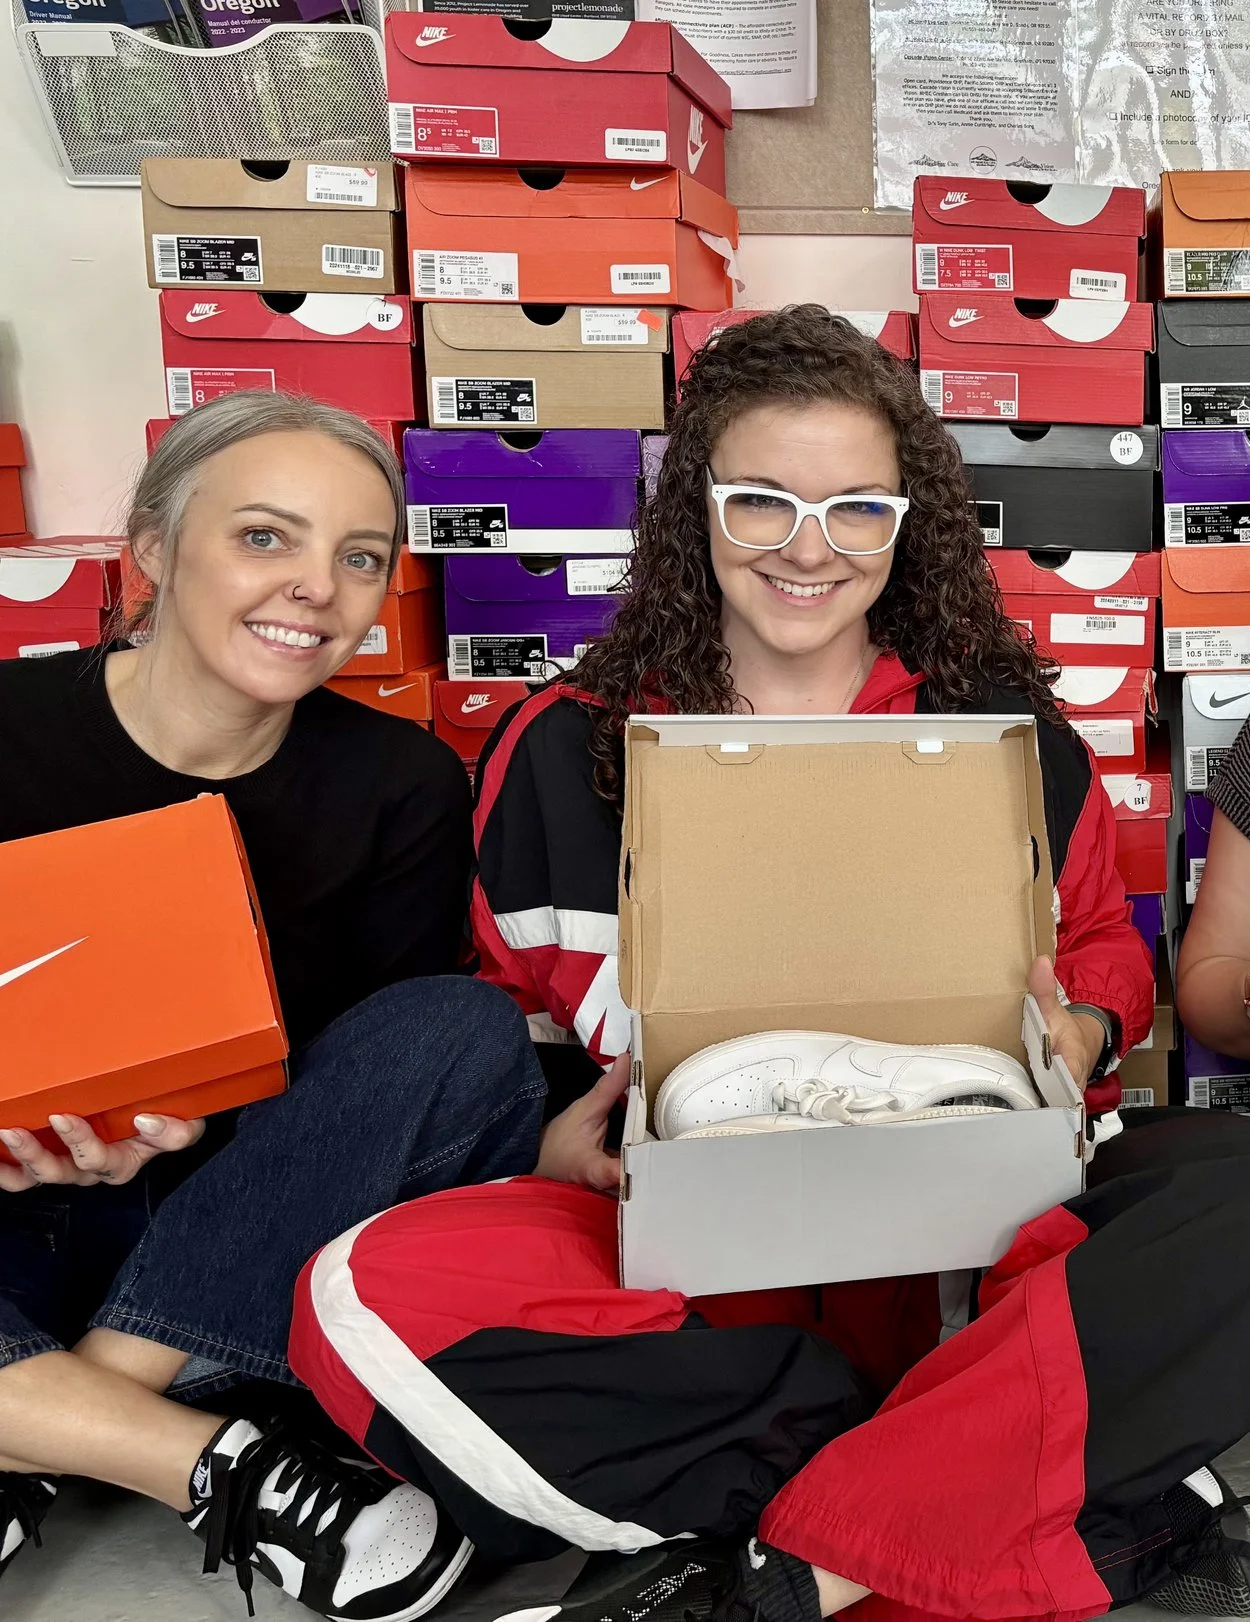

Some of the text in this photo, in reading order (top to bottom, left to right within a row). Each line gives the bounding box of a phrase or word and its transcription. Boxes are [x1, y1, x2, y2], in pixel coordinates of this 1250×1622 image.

[201, 0, 280, 14] Oregon
[551, 3, 624, 13] projectlemonade
[29, 10, 73, 20] Driver Manual
[1146, 13, 1170, 21] VITAL
[1226, 14, 1245, 22] MAIL
[241, 17, 272, 25] conductor
[422, 26, 448, 38] NIKE
[1165, 29, 1177, 37] BY
[1157, 66, 1177, 77] Sign
[1120, 113, 1152, 122] Include
[1210, 114, 1219, 122] of
[944, 191, 969, 204] NIKE
[180, 250, 187, 258] 8
[181, 262, 195, 270] 9.5
[939, 259, 945, 267] 9
[439, 266, 445, 274] 8
[940, 270, 952, 278] 7.5
[440, 277, 452, 285] 9.5
[192, 303, 219, 315] NIKE
[378, 314, 392, 323] BF
[953, 309, 978, 321] NIKE
[195, 390, 205, 403] 8
[458, 392, 464, 400] 8
[944, 391, 953, 403] 9
[458, 402, 472, 410] 9.5
[1184, 403, 1192, 415] 9
[1117, 434, 1133, 443] 447
[1119, 447, 1133, 456] BF
[432, 519, 438, 527] 8
[1187, 526, 1202, 534] 10.5
[467, 694, 490, 706] NIKE
[1208, 759, 1221, 767] 9.5
[1209, 769, 1217, 777] 11
[1136, 783, 1142, 791] 7
[1134, 797, 1147, 806] BF
[192, 1463, 210, 1492] NIKE
